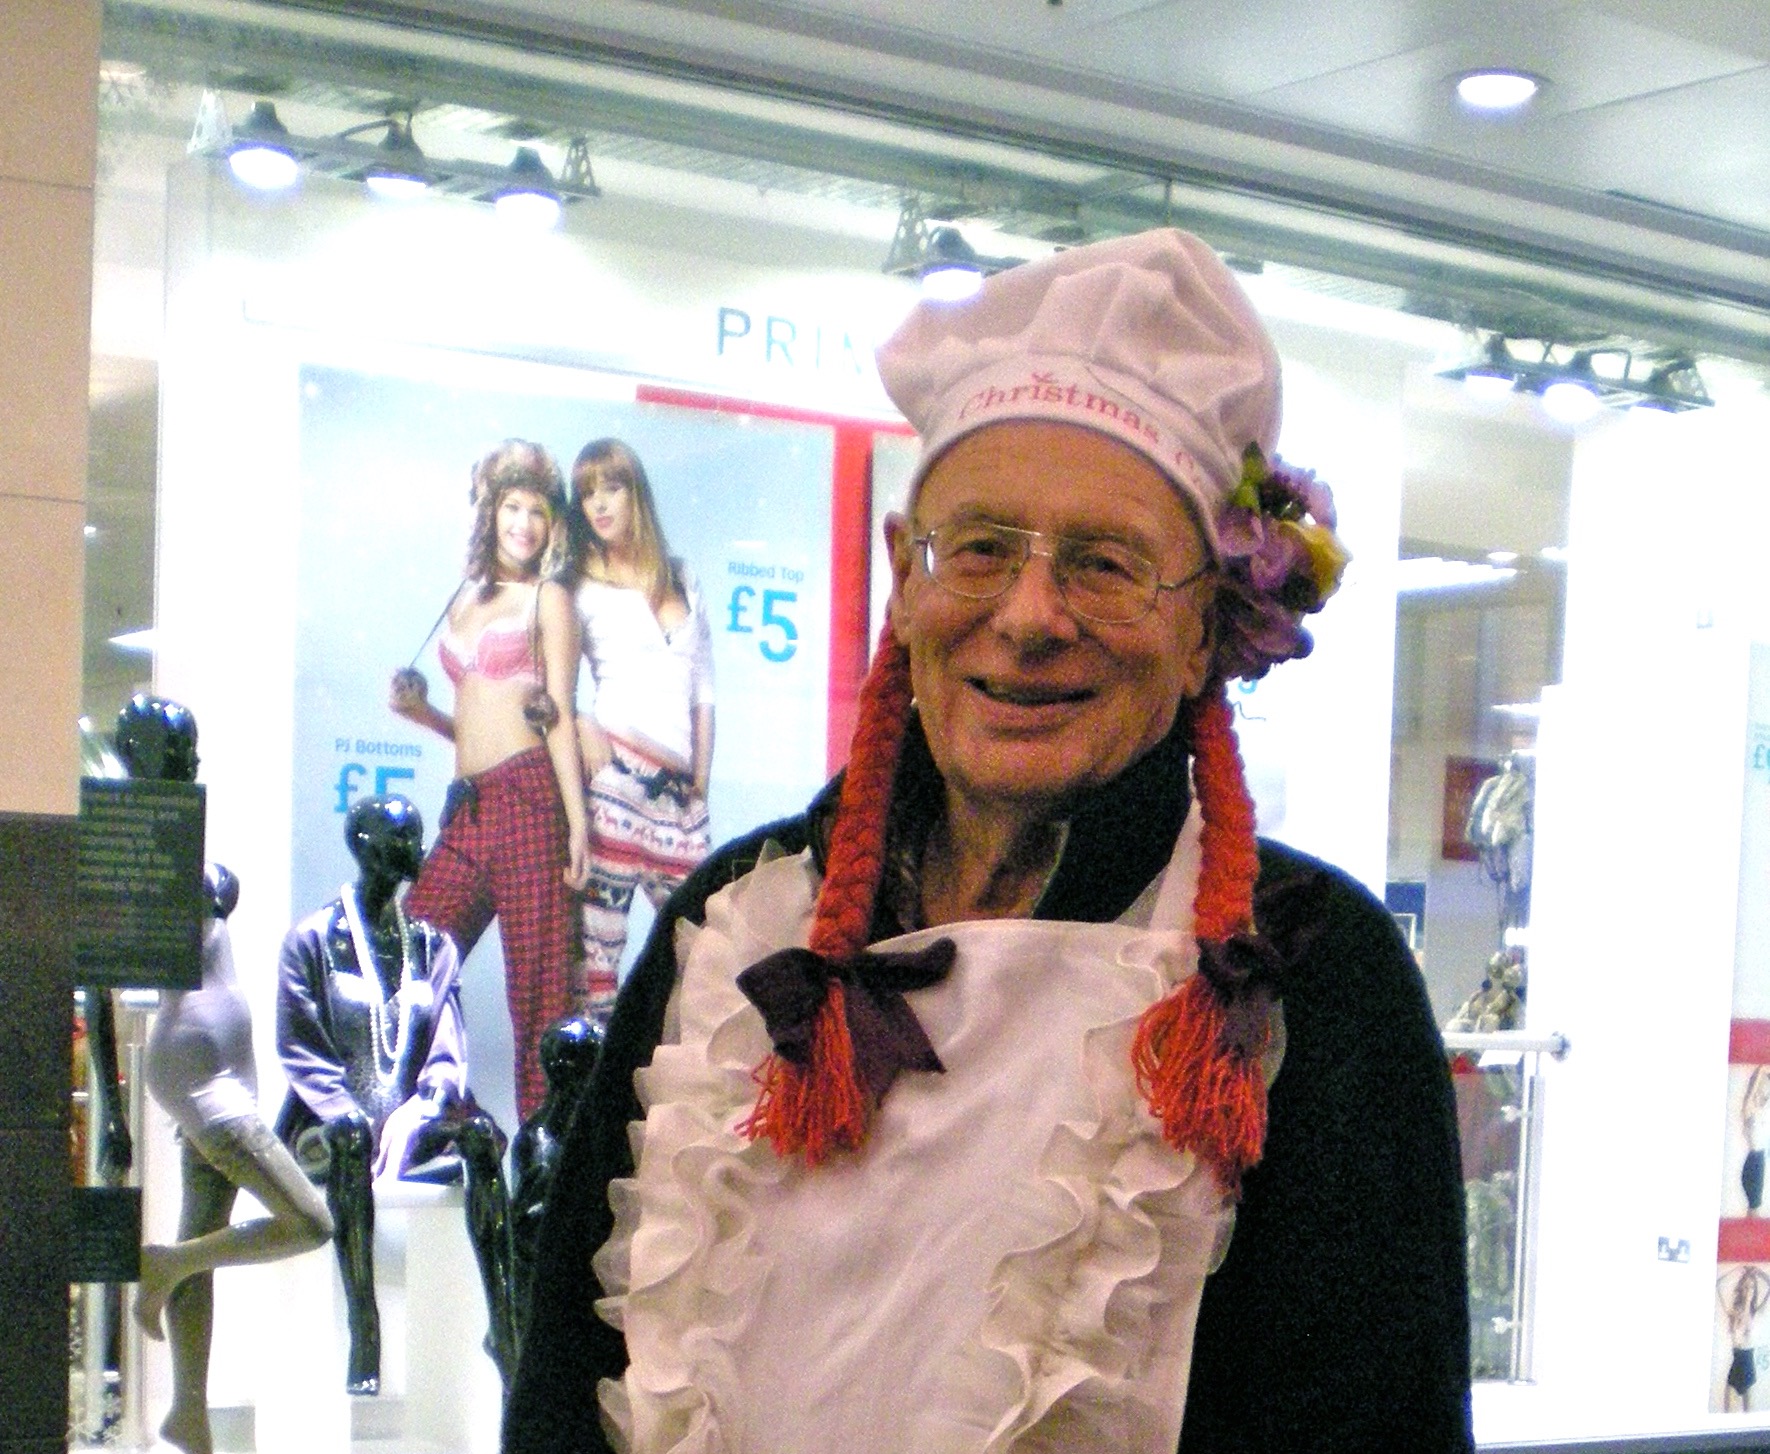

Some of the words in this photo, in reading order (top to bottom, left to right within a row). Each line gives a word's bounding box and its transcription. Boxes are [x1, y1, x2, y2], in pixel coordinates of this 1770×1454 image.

[957, 374, 1160, 447] Christmas
[727, 561, 776, 580] Ribbed
[781, 566, 805, 584] Top
[726, 586, 799, 663] £5
[355, 739, 423, 758] Bottoms
